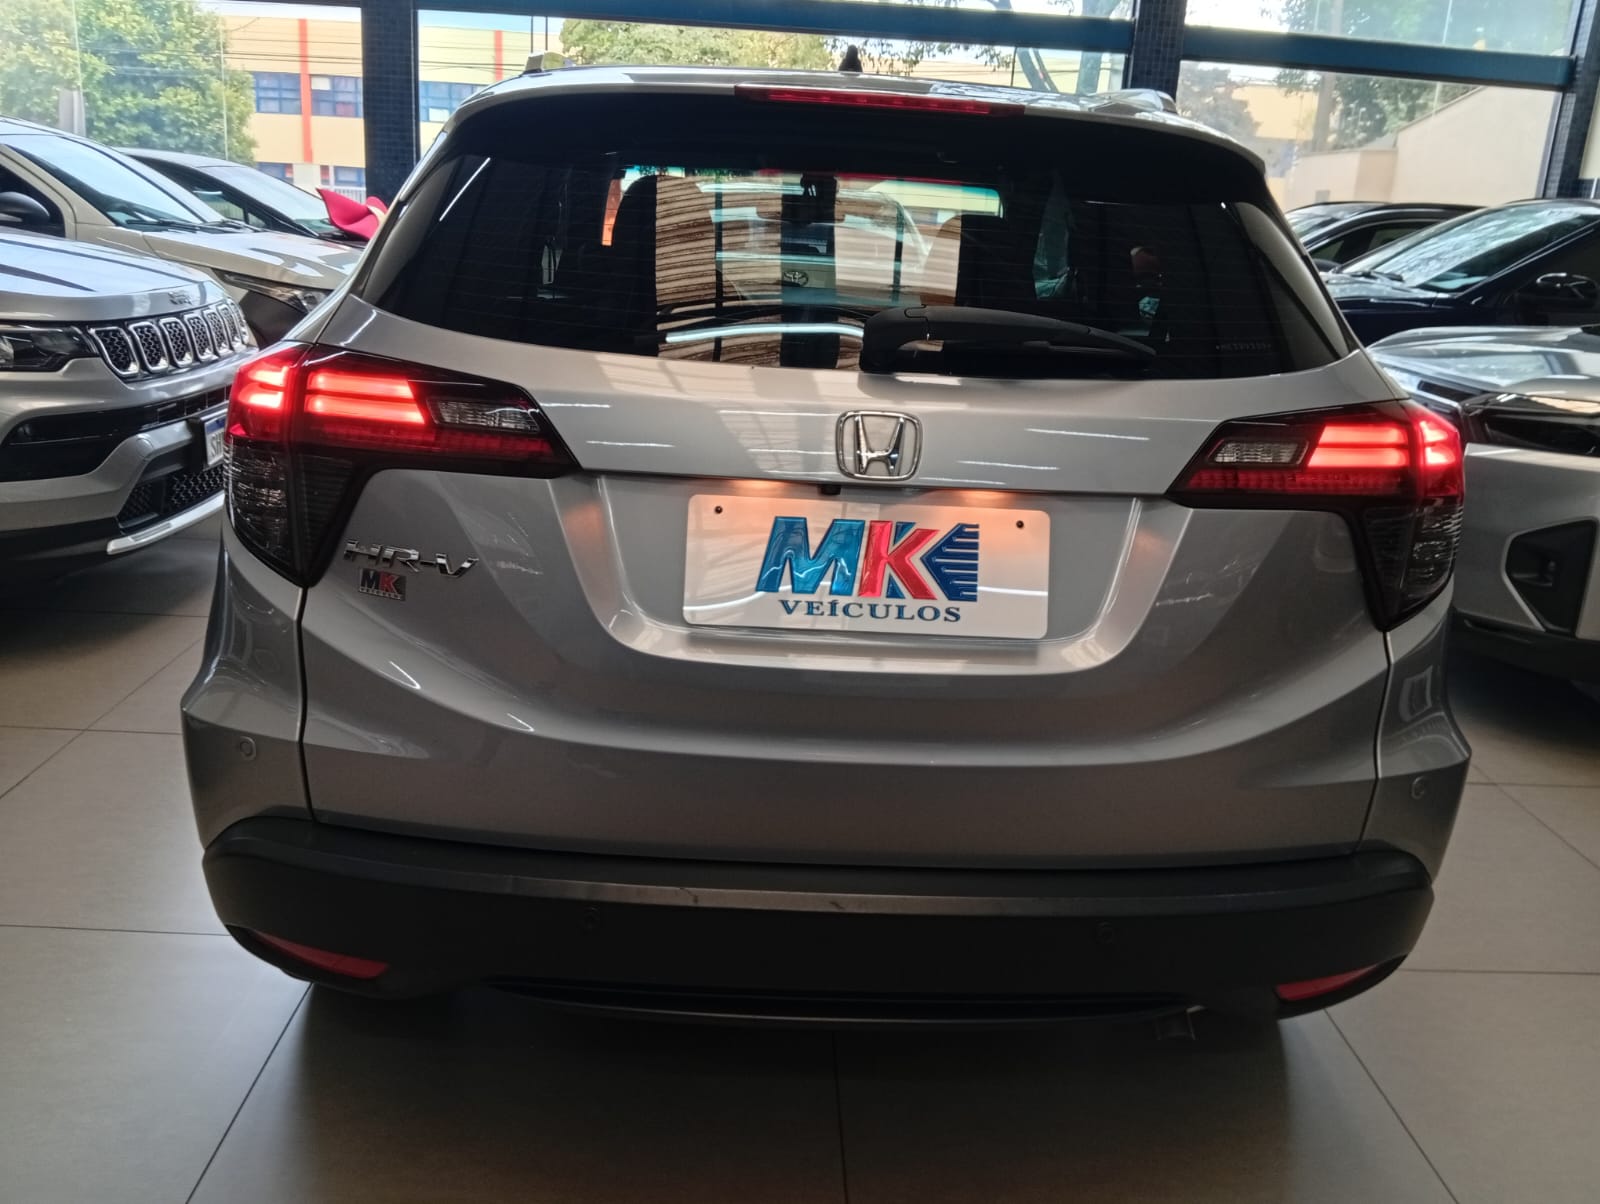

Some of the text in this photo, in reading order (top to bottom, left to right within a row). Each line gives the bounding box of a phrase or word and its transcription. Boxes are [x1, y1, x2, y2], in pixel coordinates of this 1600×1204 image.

[344, 540, 479, 578] HR-V
[755, 516, 941, 600] MK
[780, 599, 961, 622] VEÍCULOS
